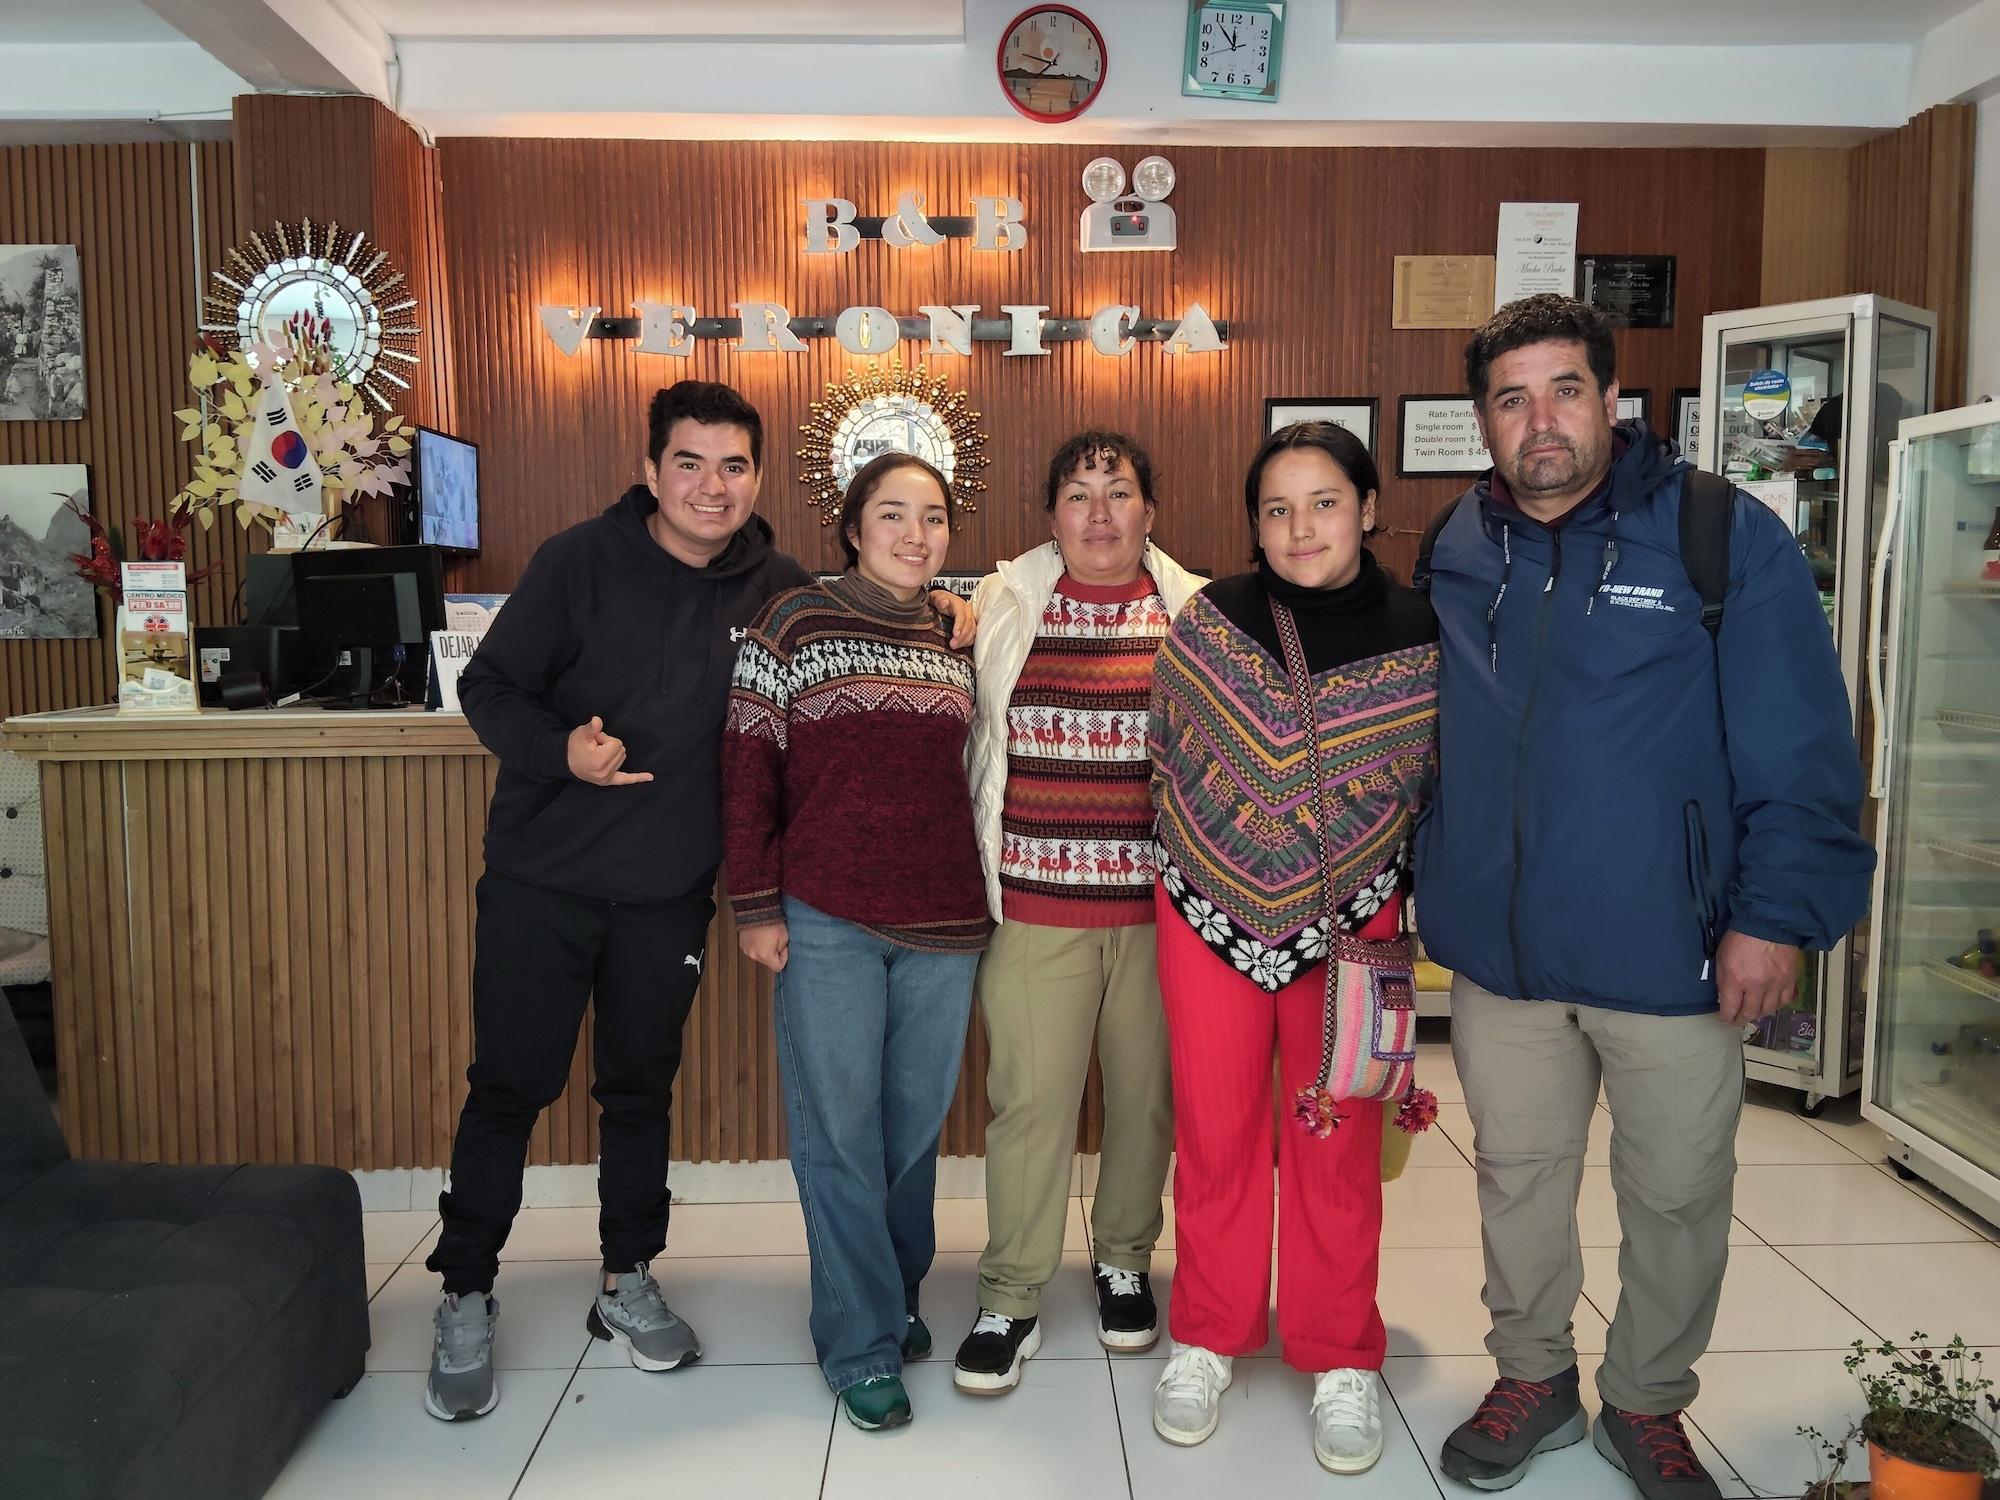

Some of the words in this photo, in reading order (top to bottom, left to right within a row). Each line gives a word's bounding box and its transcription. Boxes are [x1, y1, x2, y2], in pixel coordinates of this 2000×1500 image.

[1050, 15, 1056, 27] 12
[1216, 12, 1224, 23] 11
[1231, 14, 1242, 24] 12
[1031, 20, 1037, 32] 11
[1202, 23, 1213, 34] 10
[1260, 29, 1268, 40] 2
[1201, 41, 1209, 52] 9
[1259, 46, 1267, 57] 3
[1200, 56, 1208, 68] 8
[1257, 62, 1265, 73] 4
[1211, 71, 1219, 82] 7
[1227, 72, 1235, 84] 6
[1243, 74, 1251, 85] 5
[539, 302, 1229, 358] VERONICA
[1450, 410, 1476, 418] Tarifa
[1415, 423, 1440, 432] Single
[1471, 422, 1477, 431] $
[1470, 435, 1475, 443] $
[1414, 448, 1435, 456] Twin
[1438, 448, 1464, 456] Room
[1468, 447, 1474, 456] $
[1476, 448, 1487, 456] 45
[1632, 586, 1664, 598] BRAND
[439, 636, 475, 658] DEJAR
